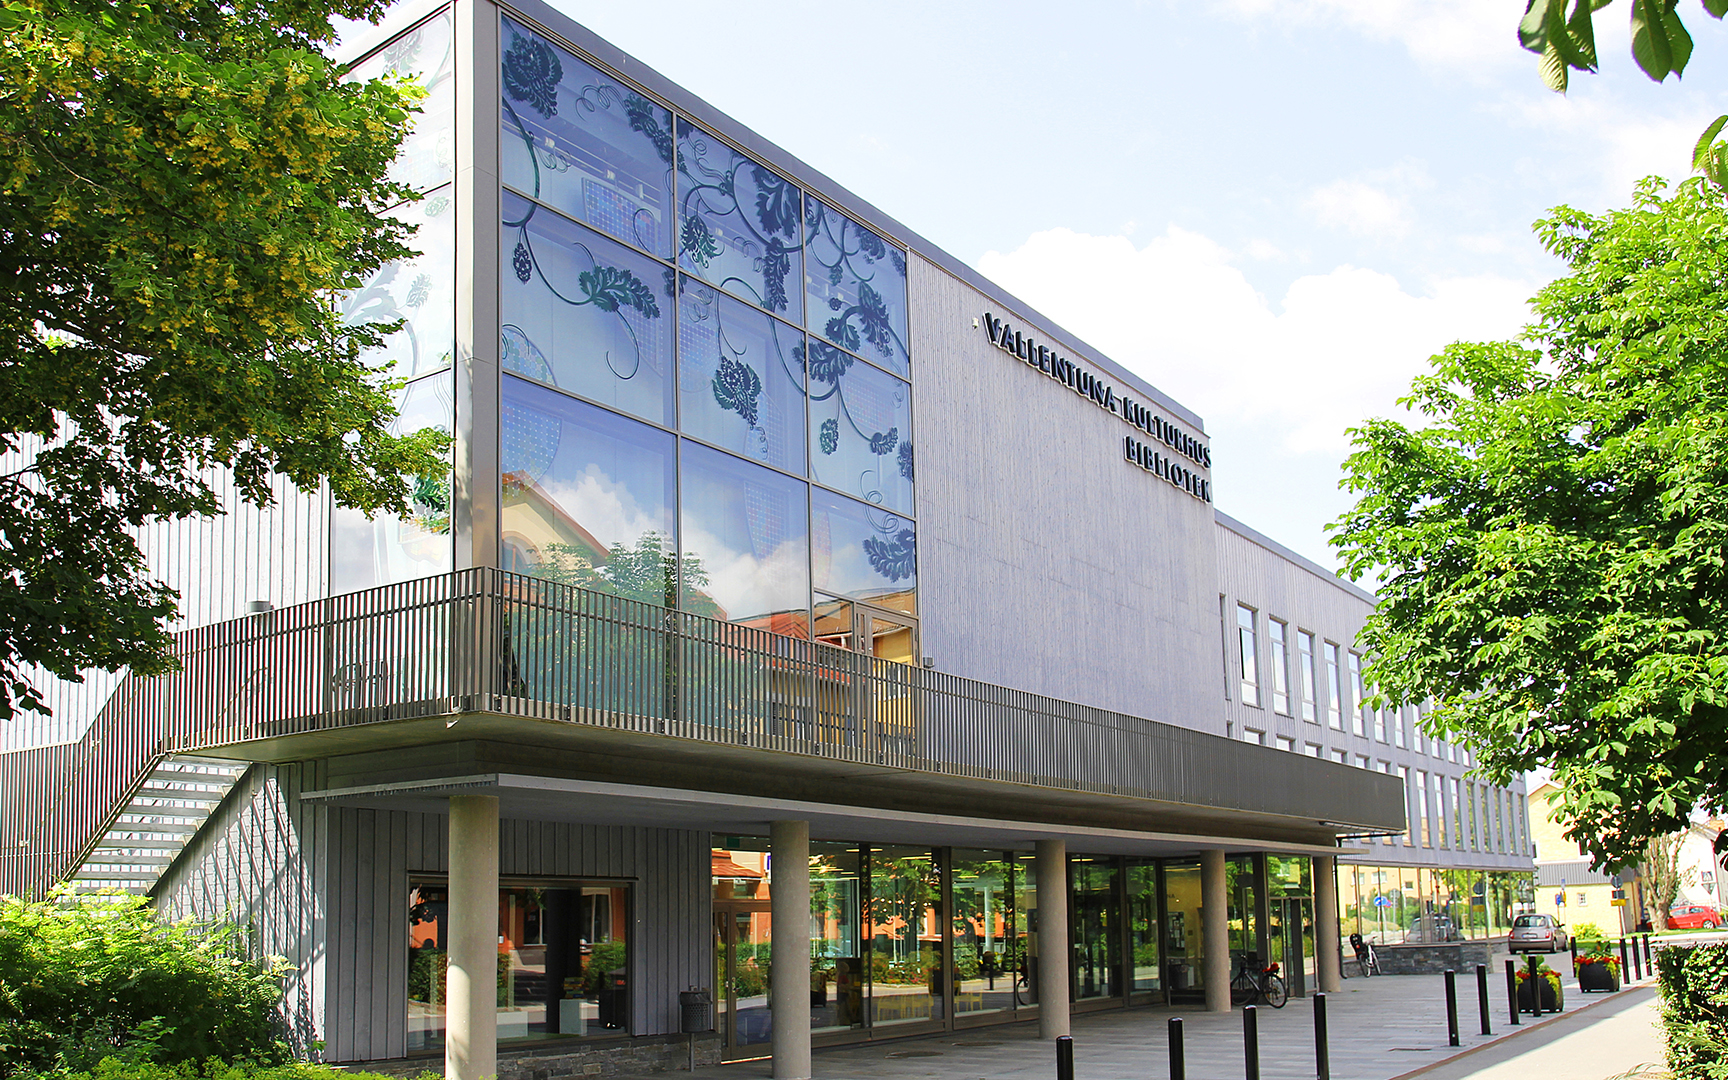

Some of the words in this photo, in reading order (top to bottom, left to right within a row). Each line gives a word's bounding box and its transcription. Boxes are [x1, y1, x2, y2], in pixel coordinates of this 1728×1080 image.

[983, 312, 1117, 413] VALLENTUNA
[1122, 396, 1212, 469] KULTURHUS
[1123, 435, 1211, 503] BIBLIOTEK
